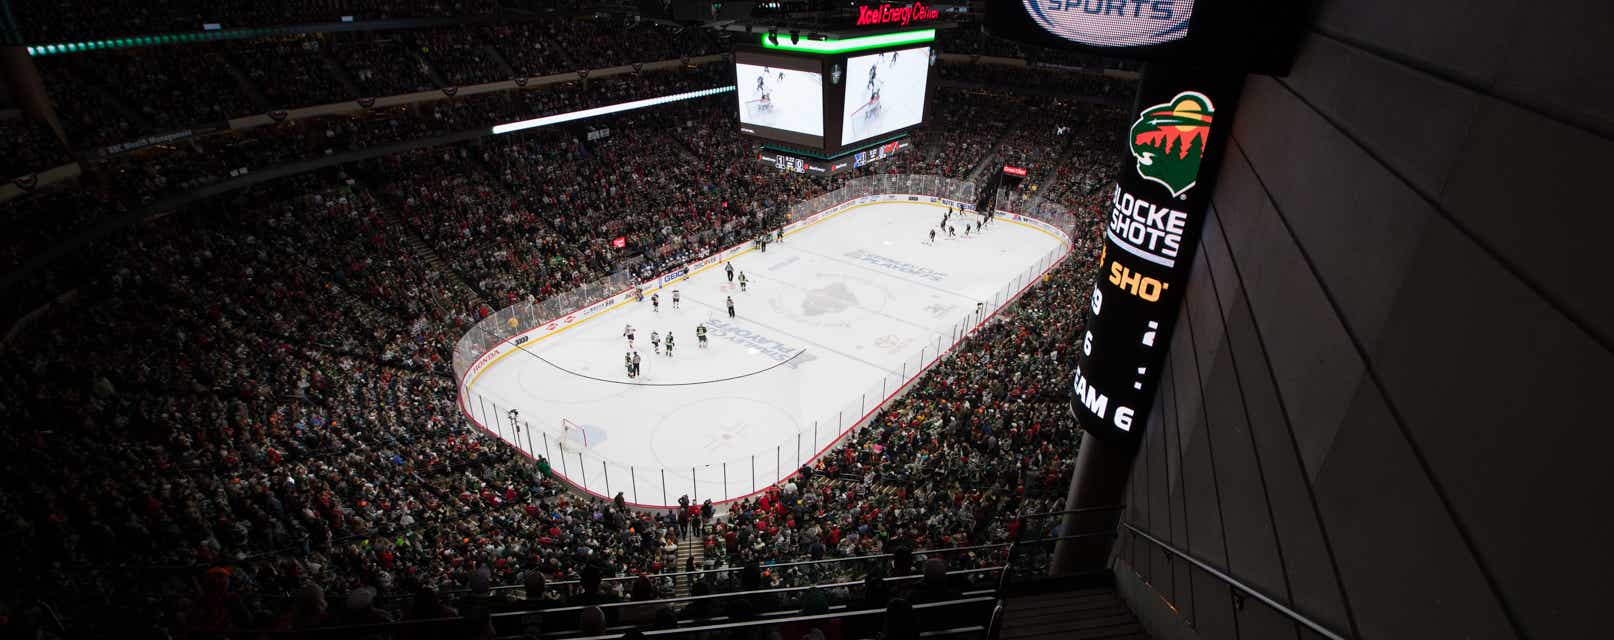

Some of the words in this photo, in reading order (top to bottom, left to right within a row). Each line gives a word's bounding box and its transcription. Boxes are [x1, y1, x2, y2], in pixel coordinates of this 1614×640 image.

[856, 5, 882, 26] Xcel
[882, 3, 912, 26] Energy
[1048, 0, 1173, 20] SPORTS
[1110, 208, 1181, 258] SHOTS
[664, 269, 685, 283] GEIC
[1109, 261, 1169, 302] SHO
[1083, 330, 1093, 356] 6
